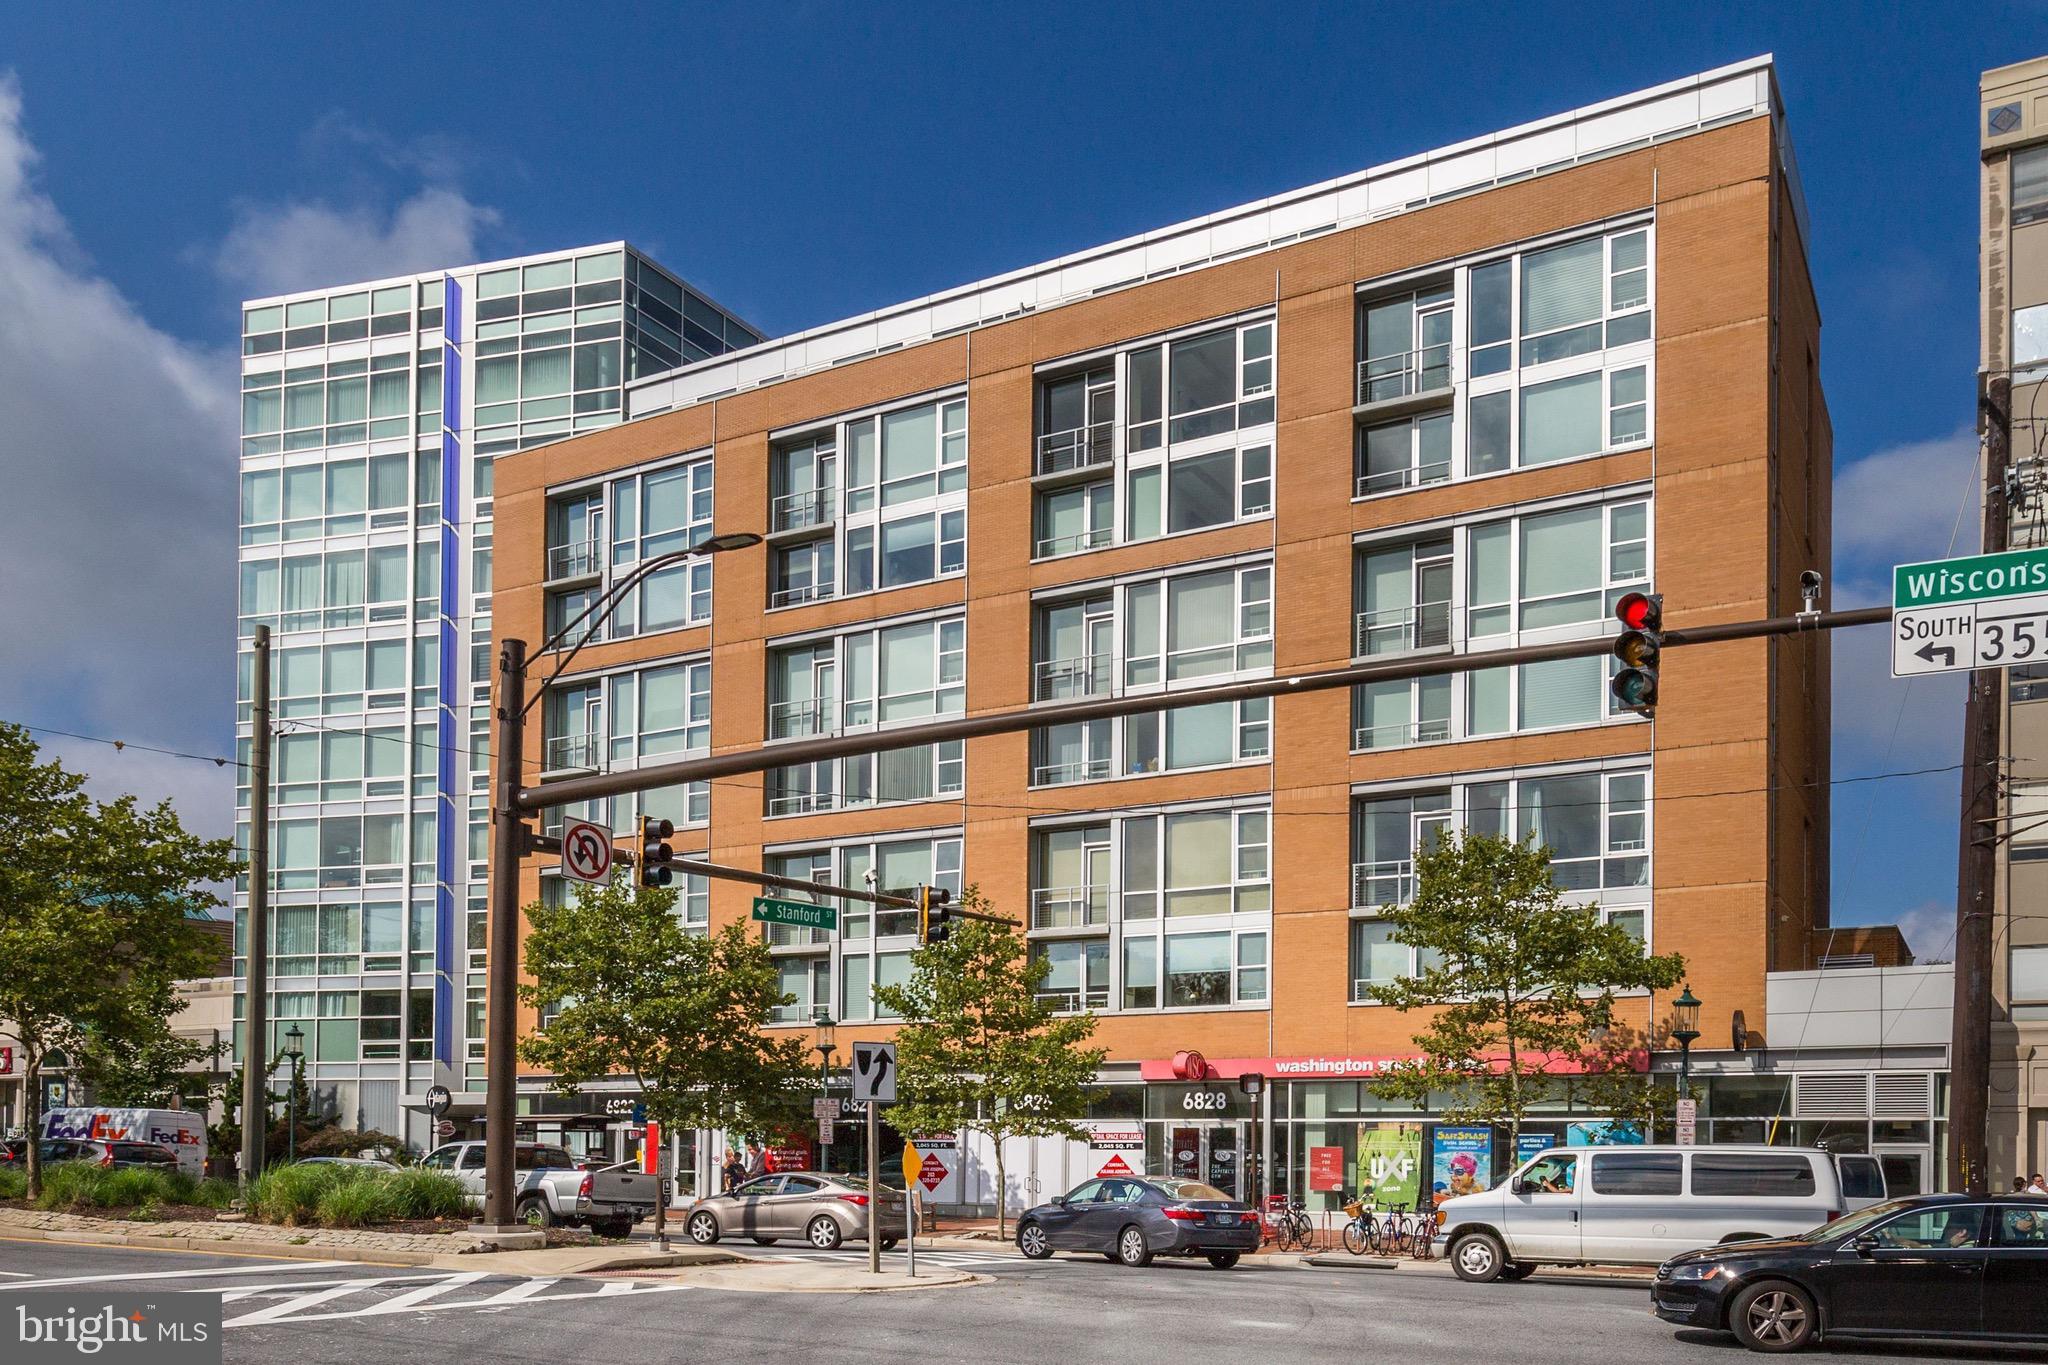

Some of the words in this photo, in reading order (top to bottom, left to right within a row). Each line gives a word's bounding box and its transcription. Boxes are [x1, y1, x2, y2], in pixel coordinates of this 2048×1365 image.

[1908, 563, 2047, 599] Wiscons
[1900, 616, 1971, 641] SOUTH
[1981, 621, 2048, 661] 35
[776, 905, 820, 923] Stanford
[1275, 1057, 1374, 1075] washington
[842, 1097, 868, 1113] 682
[1183, 1092, 1227, 1110] 6828
[151, 1128, 200, 1145] FedEx
[1371, 1151, 1414, 1187] UXF
